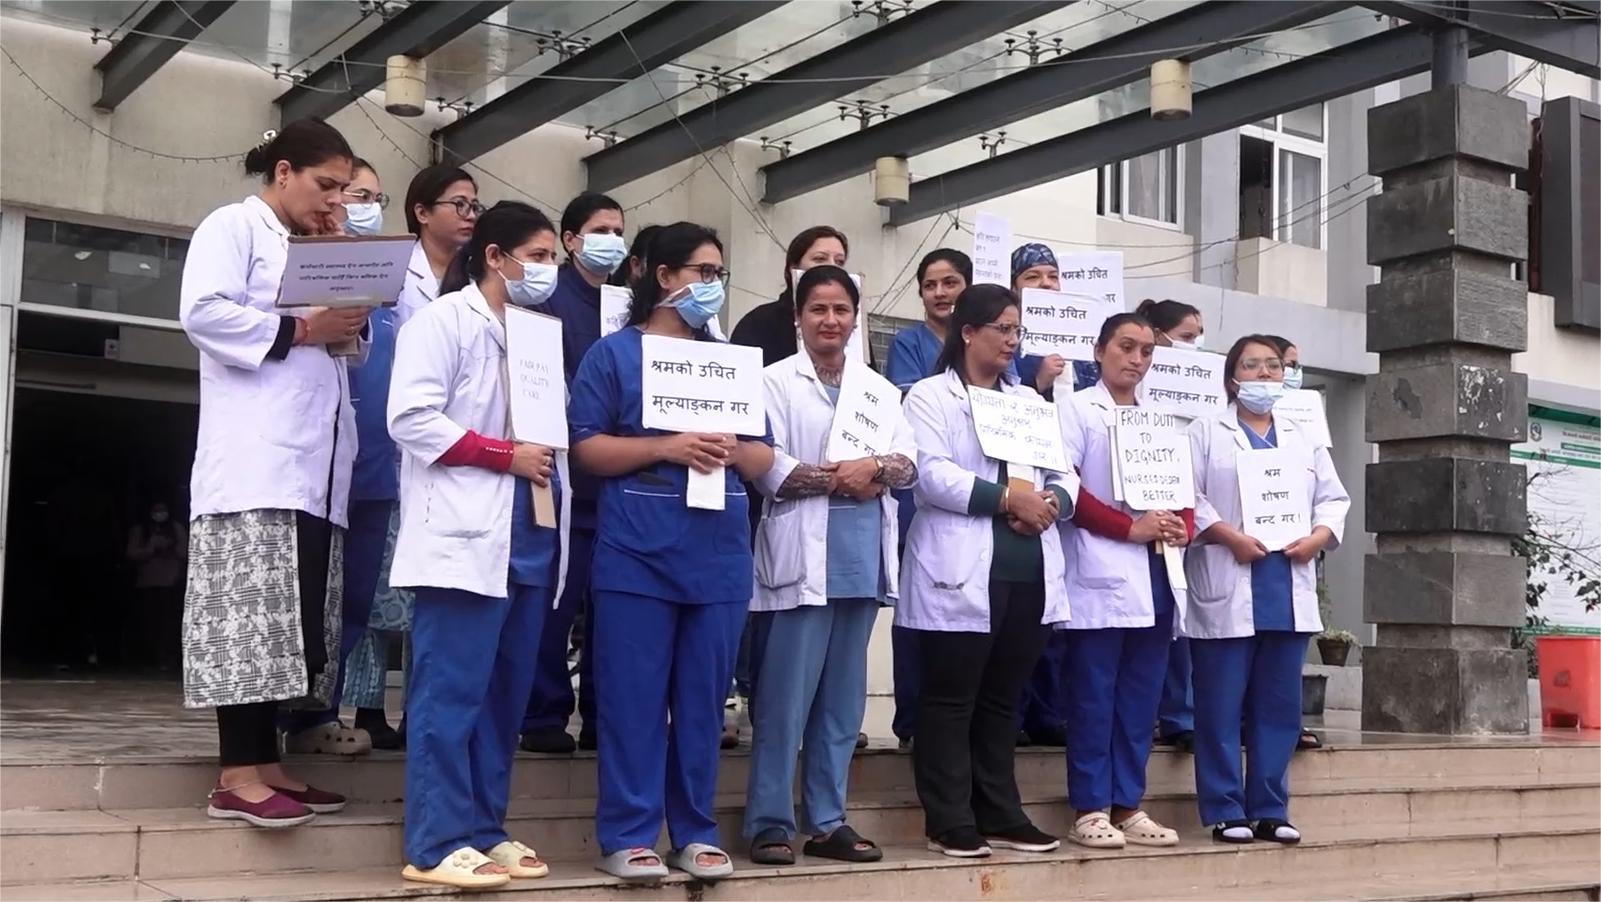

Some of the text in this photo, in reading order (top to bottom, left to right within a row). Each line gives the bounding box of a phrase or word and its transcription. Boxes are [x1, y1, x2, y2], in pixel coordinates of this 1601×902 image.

[1087, 266, 1108, 280] उचित
[1026, 305, 1087, 319] श्रमको उचित
[1081, 335, 1095, 345] गर
[651, 360, 736, 379] श्रमको उचित
[1151, 363, 1212, 379] श्रमको उचित
[863, 391, 879, 407] श्रम
[1149, 388, 1218, 405] मूल्याङ्कन गर
[652, 395, 749, 415] मूल्याङ्कन गर
[854, 411, 879, 433] शोषण
[1121, 410, 1149, 426] FROM
[1140, 432, 1152, 444] TO
[1264, 468, 1281, 478] श्रम
[1142, 490, 1177, 503] BETTER
[1261, 490, 1289, 502] शोषण
